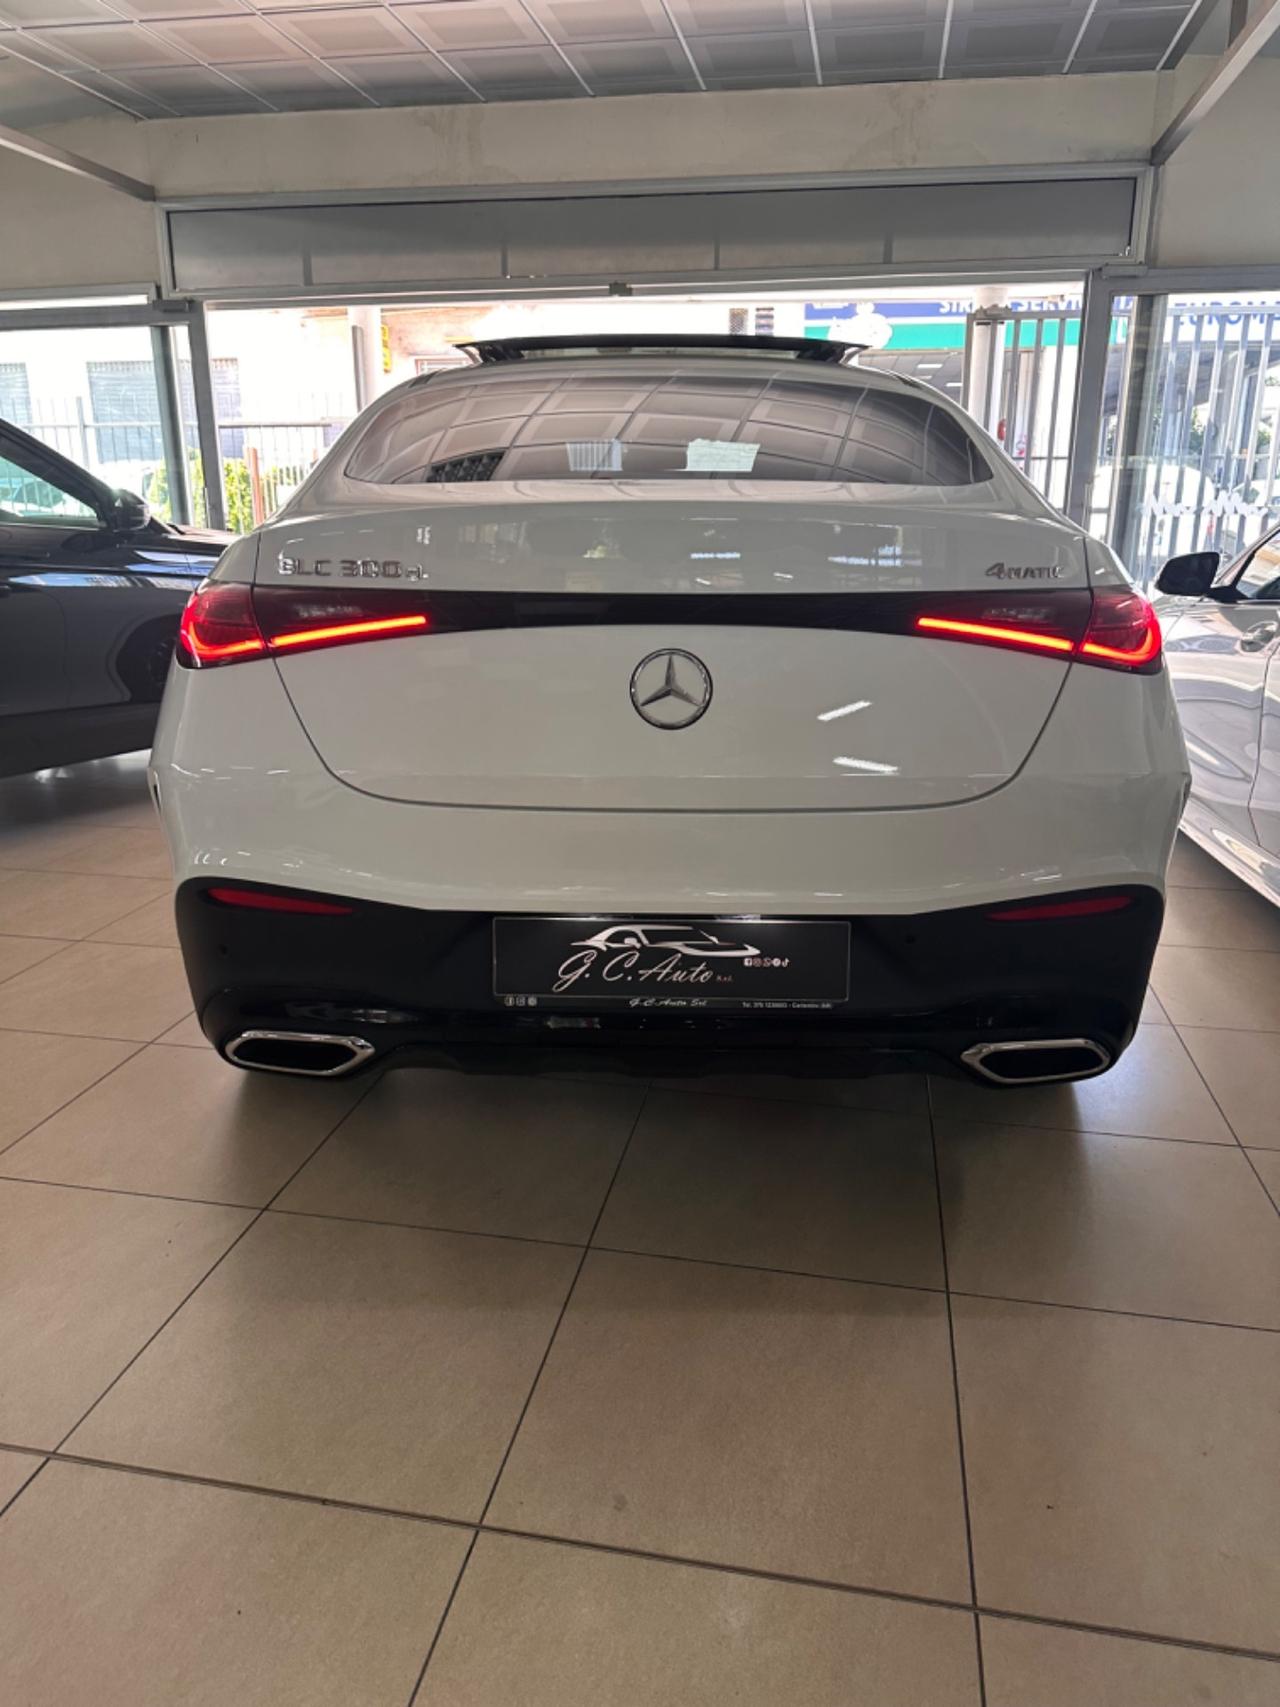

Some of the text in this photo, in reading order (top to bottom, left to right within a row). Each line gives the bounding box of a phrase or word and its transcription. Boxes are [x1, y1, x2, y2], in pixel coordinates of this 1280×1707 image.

[339, 558, 402, 578] 300
[985, 562, 1064, 580] 4MATIC
[638, 953, 714, 983] Auto
